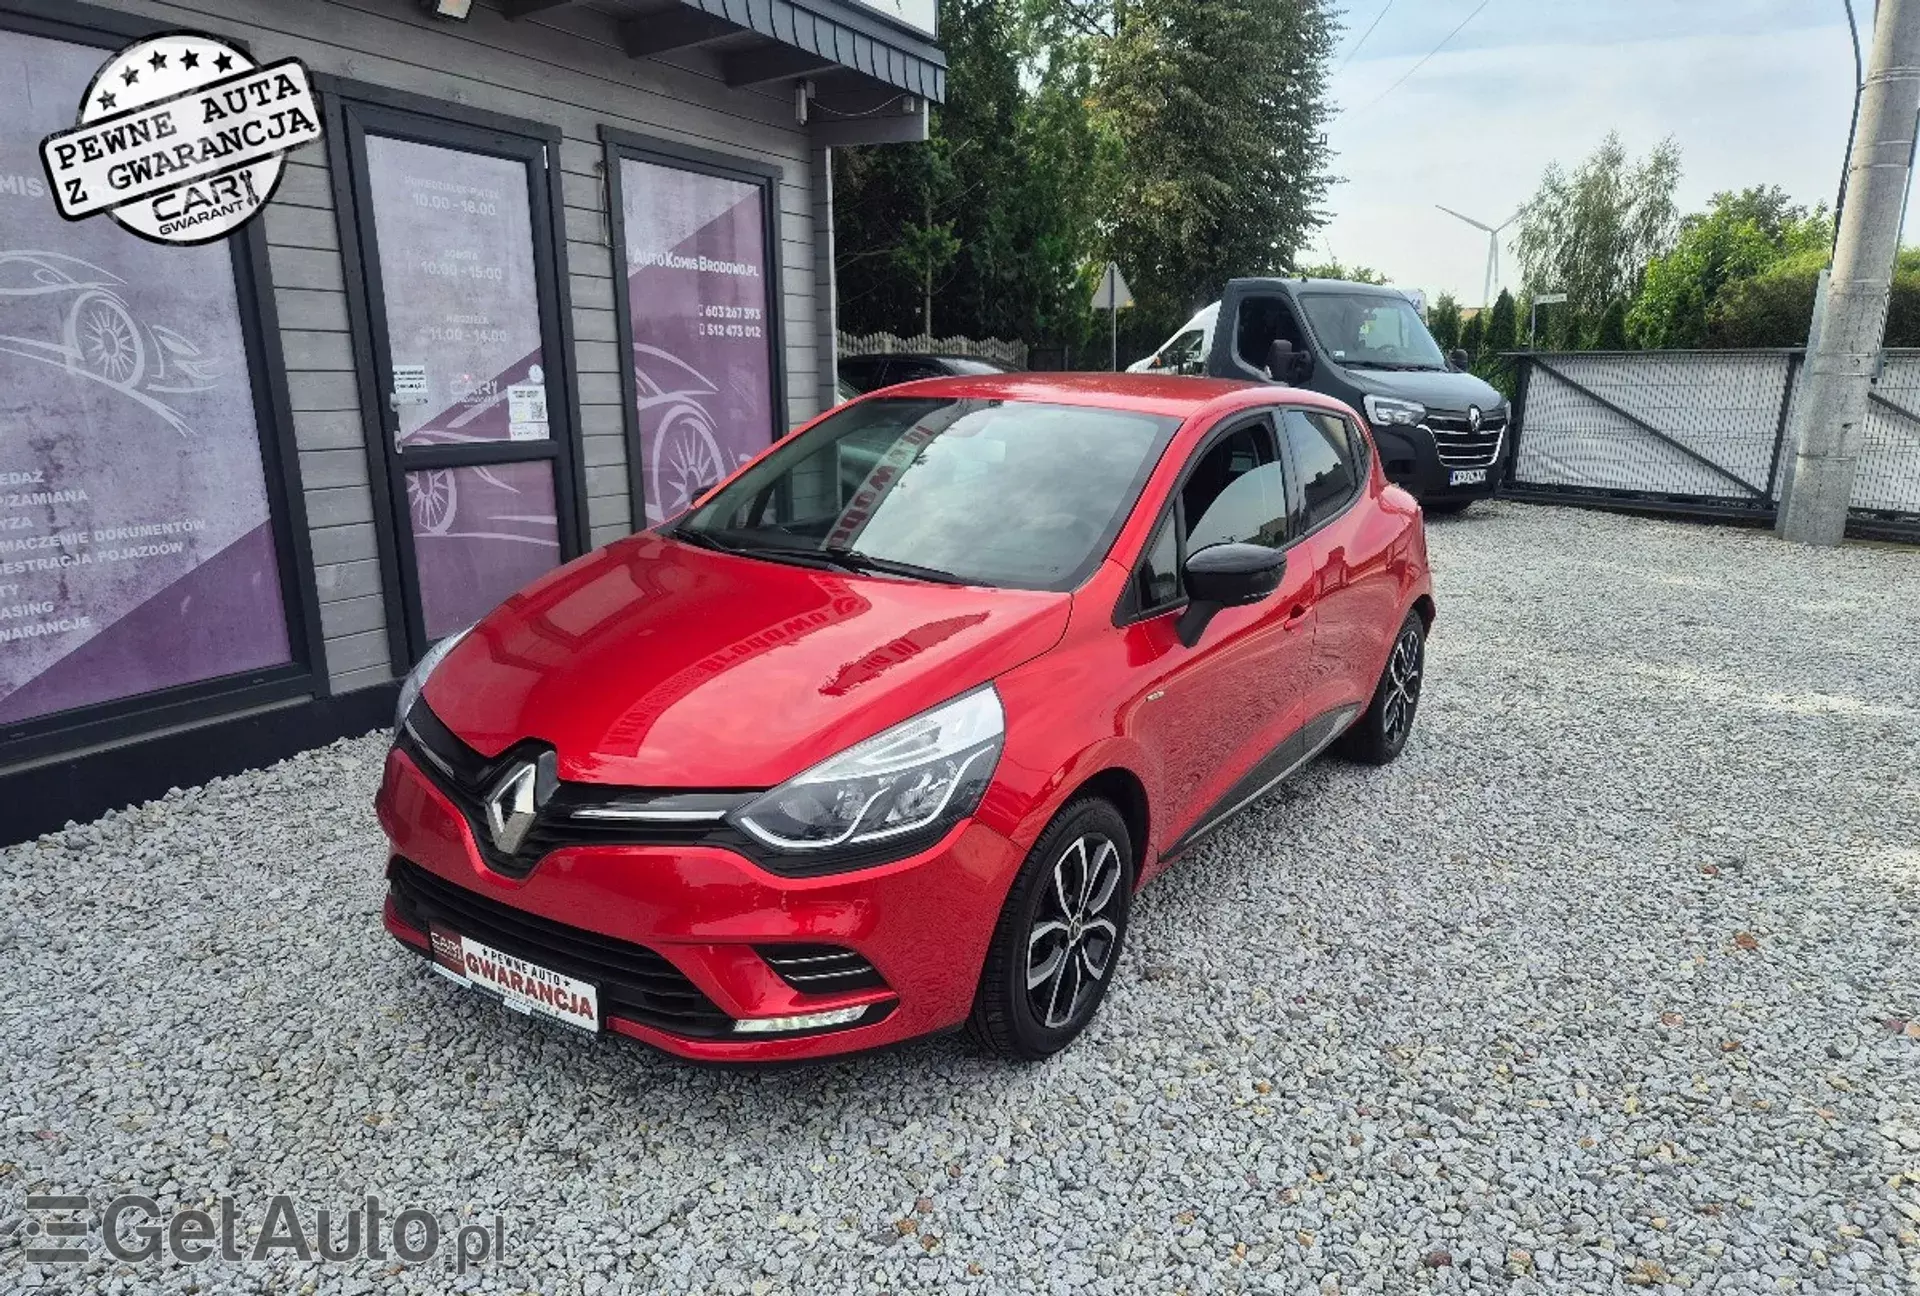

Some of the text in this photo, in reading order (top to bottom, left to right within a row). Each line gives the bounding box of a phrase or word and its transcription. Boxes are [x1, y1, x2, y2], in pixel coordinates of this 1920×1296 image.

[706, 305, 723, 318] 603
[726, 306, 742, 319] 267
[707, 324, 724, 336] 512
[745, 326, 761, 338] 012
[94, 519, 205, 542] DOKUMENTÓW
[97, 541, 183, 563] POJAZDÓW
[491, 951, 560, 987] PEWNE AUTO
[466, 952, 594, 1020] GWARANCJA
